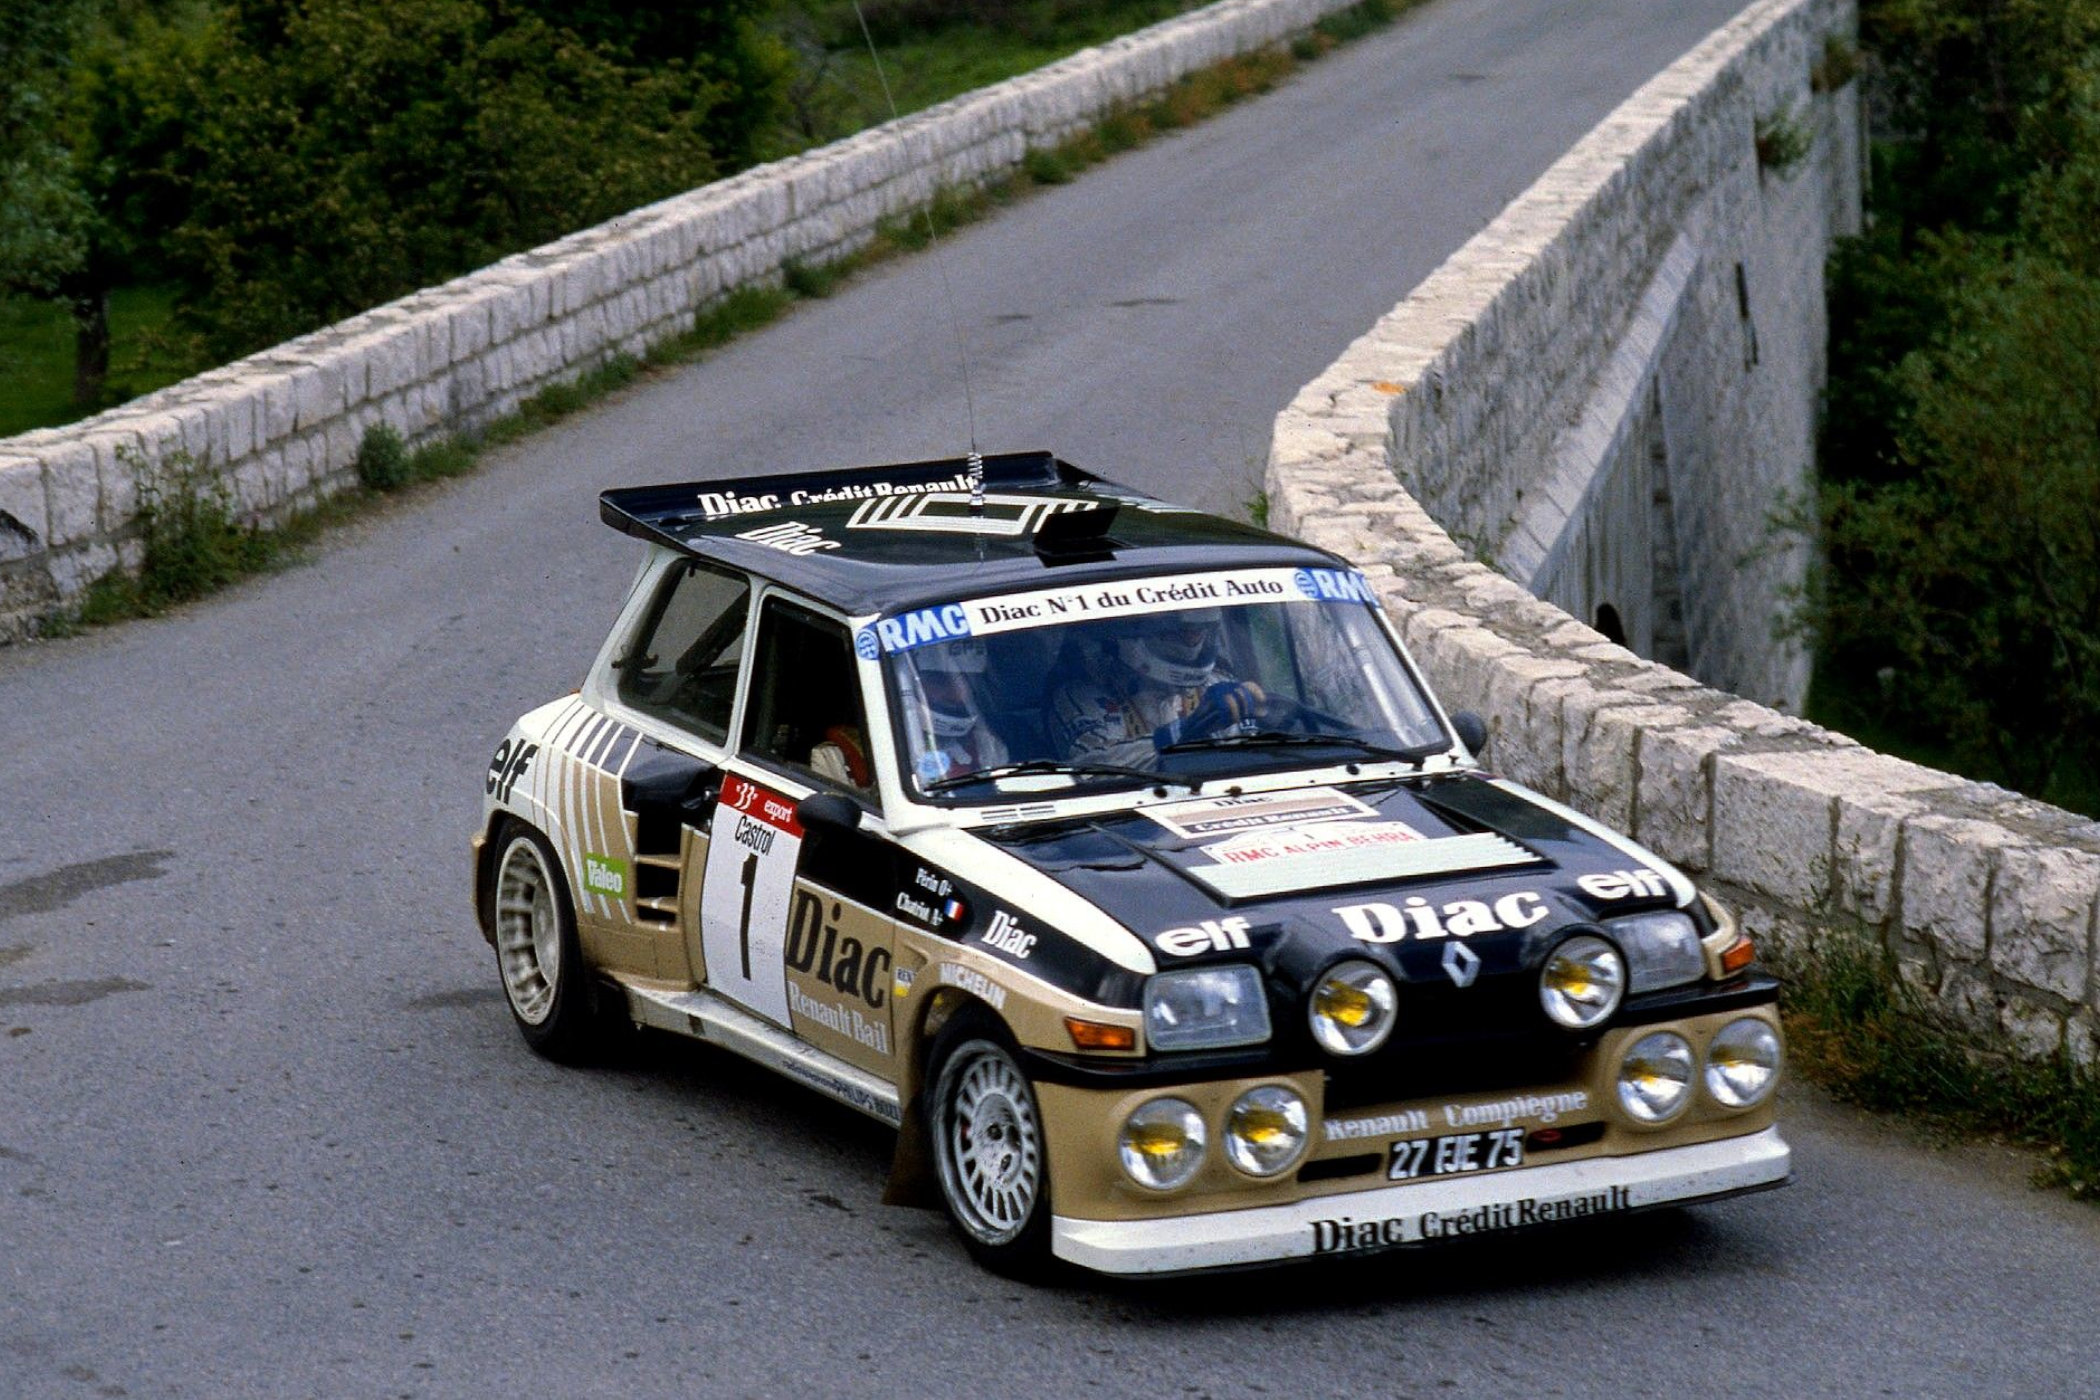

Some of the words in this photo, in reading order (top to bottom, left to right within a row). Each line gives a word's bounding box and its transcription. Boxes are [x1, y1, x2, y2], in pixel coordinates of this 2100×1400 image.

[698, 491, 781, 516] Diac
[735, 521, 842, 556] Diac
[979, 605, 1042, 625] Diac
[1099, 588, 1131, 608] du
[1136, 581, 1217, 604] Crédit
[1225, 579, 1284, 596] Auto
[876, 604, 969, 652] RMC
[486, 738, 540, 806] elf
[764, 800, 793, 823] export
[735, 815, 777, 856] Castrol
[1224, 847, 1282, 864] RMC
[587, 859, 623, 893] Valeo
[1577, 869, 1667, 899] elf
[740, 853, 758, 981] 1
[981, 910, 1038, 959] Diac
[1154, 915, 1254, 956] elf
[1332, 891, 1550, 944] Diac
[784, 888, 891, 1009] Diac
[940, 961, 1007, 1010] MICHELIN
[787, 980, 852, 1031] Renault
[853, 1010, 890, 1055] Bail
[1323, 1110, 1429, 1141] Renault
[1389, 1140, 1429, 1180] 27
[1486, 1128, 1526, 1168] 75
[1310, 1216, 1403, 1254] Diac
[1419, 1201, 1513, 1241] Crédit
[1515, 1184, 1633, 1227] Renault
